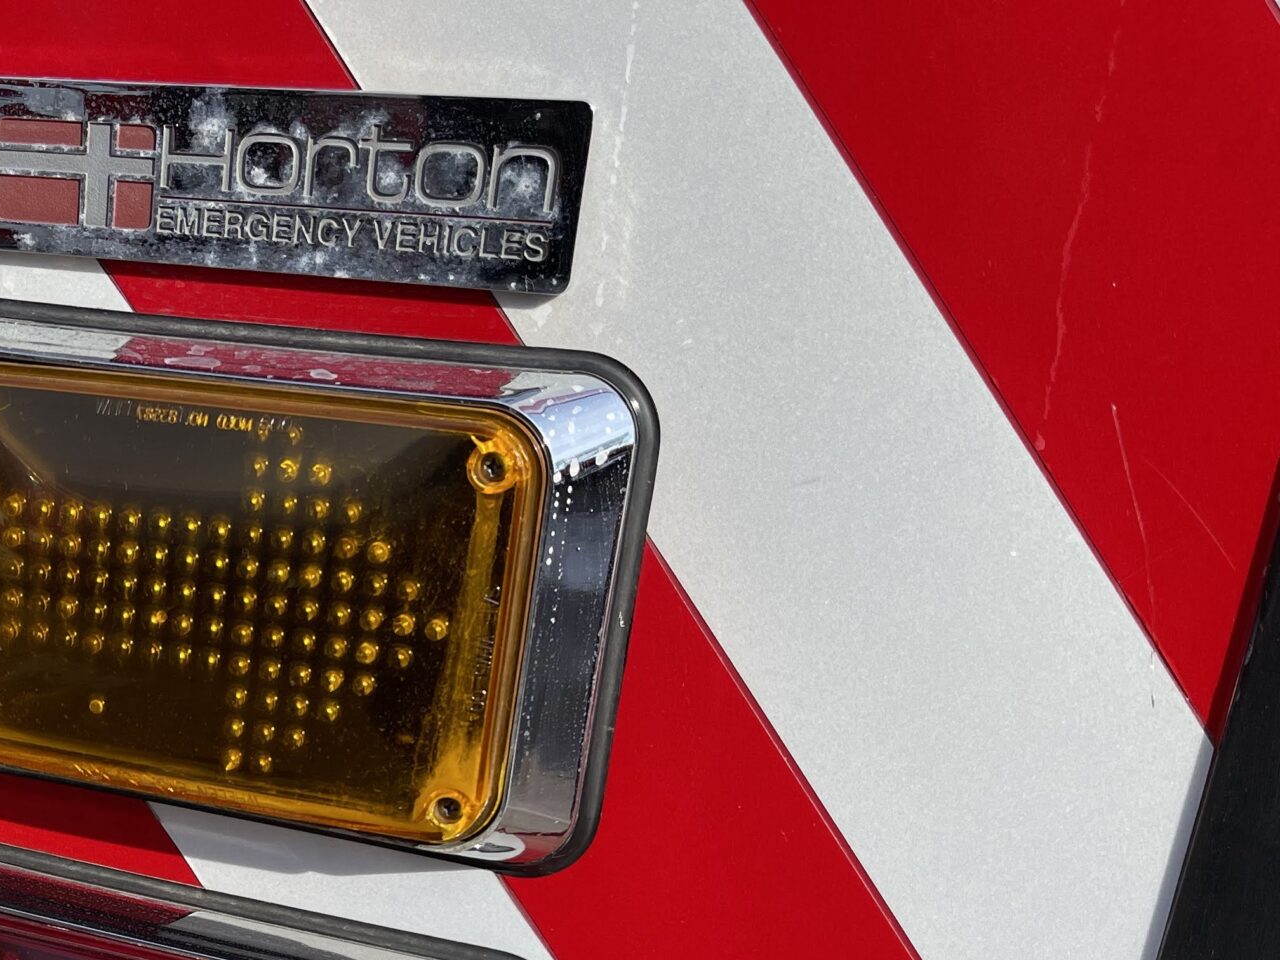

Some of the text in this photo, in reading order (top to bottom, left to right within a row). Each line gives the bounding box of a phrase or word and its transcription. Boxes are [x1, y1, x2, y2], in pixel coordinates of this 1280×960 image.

[160, 124, 557, 213] Horton
[156, 205, 548, 262] EMERGENCY VEHICLES
